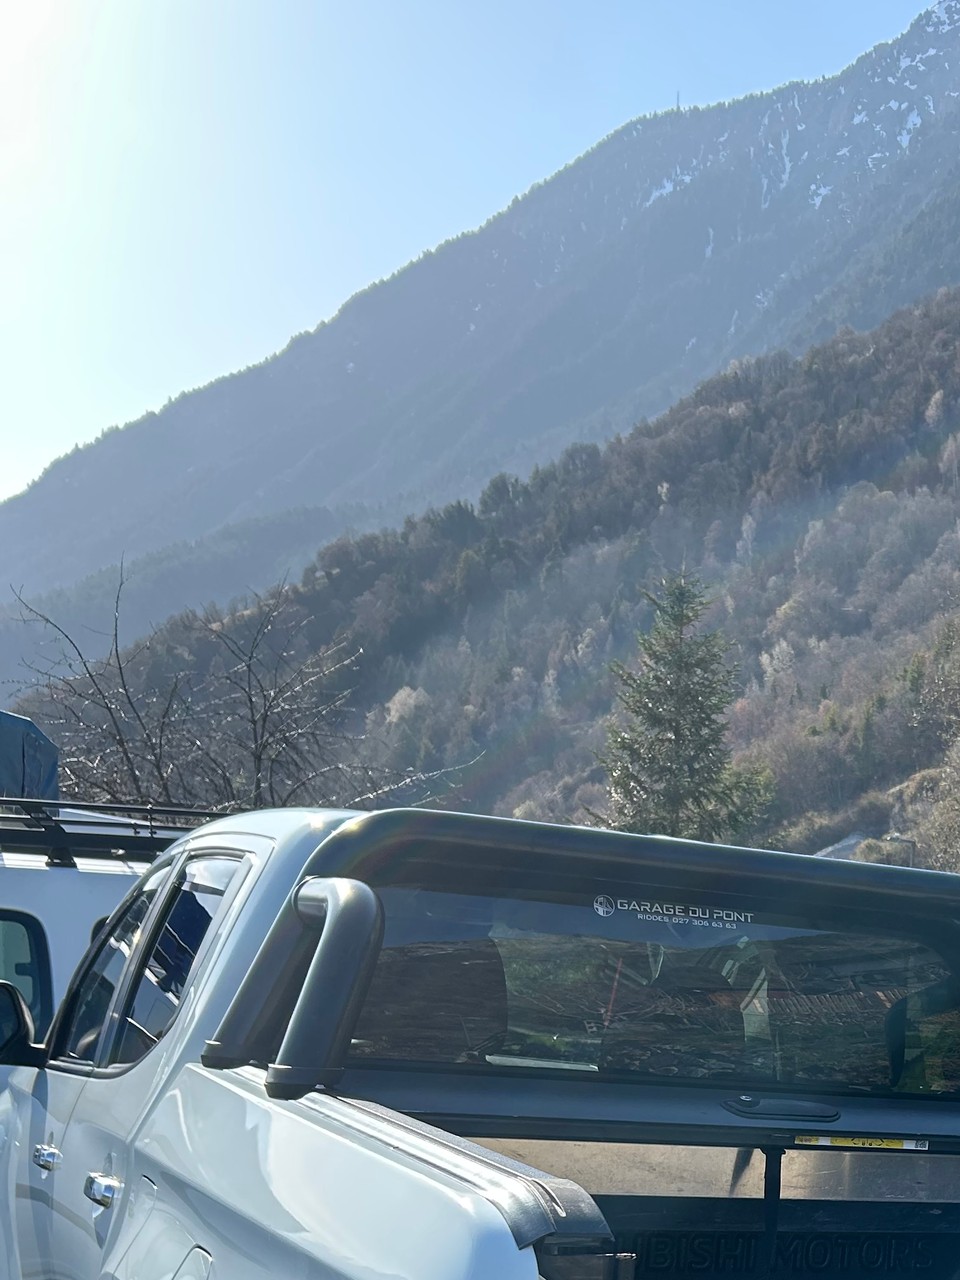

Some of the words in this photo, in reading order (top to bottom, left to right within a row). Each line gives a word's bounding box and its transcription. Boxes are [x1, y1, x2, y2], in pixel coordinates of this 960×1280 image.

[617, 899, 685, 916] GARAGE
[689, 906, 709, 918] DU
[713, 909, 754, 923] PONT
[637, 913, 669, 923] RIDDES
[692, 919, 709, 927] 306
[771, 1236, 934, 1270] MOTORS
